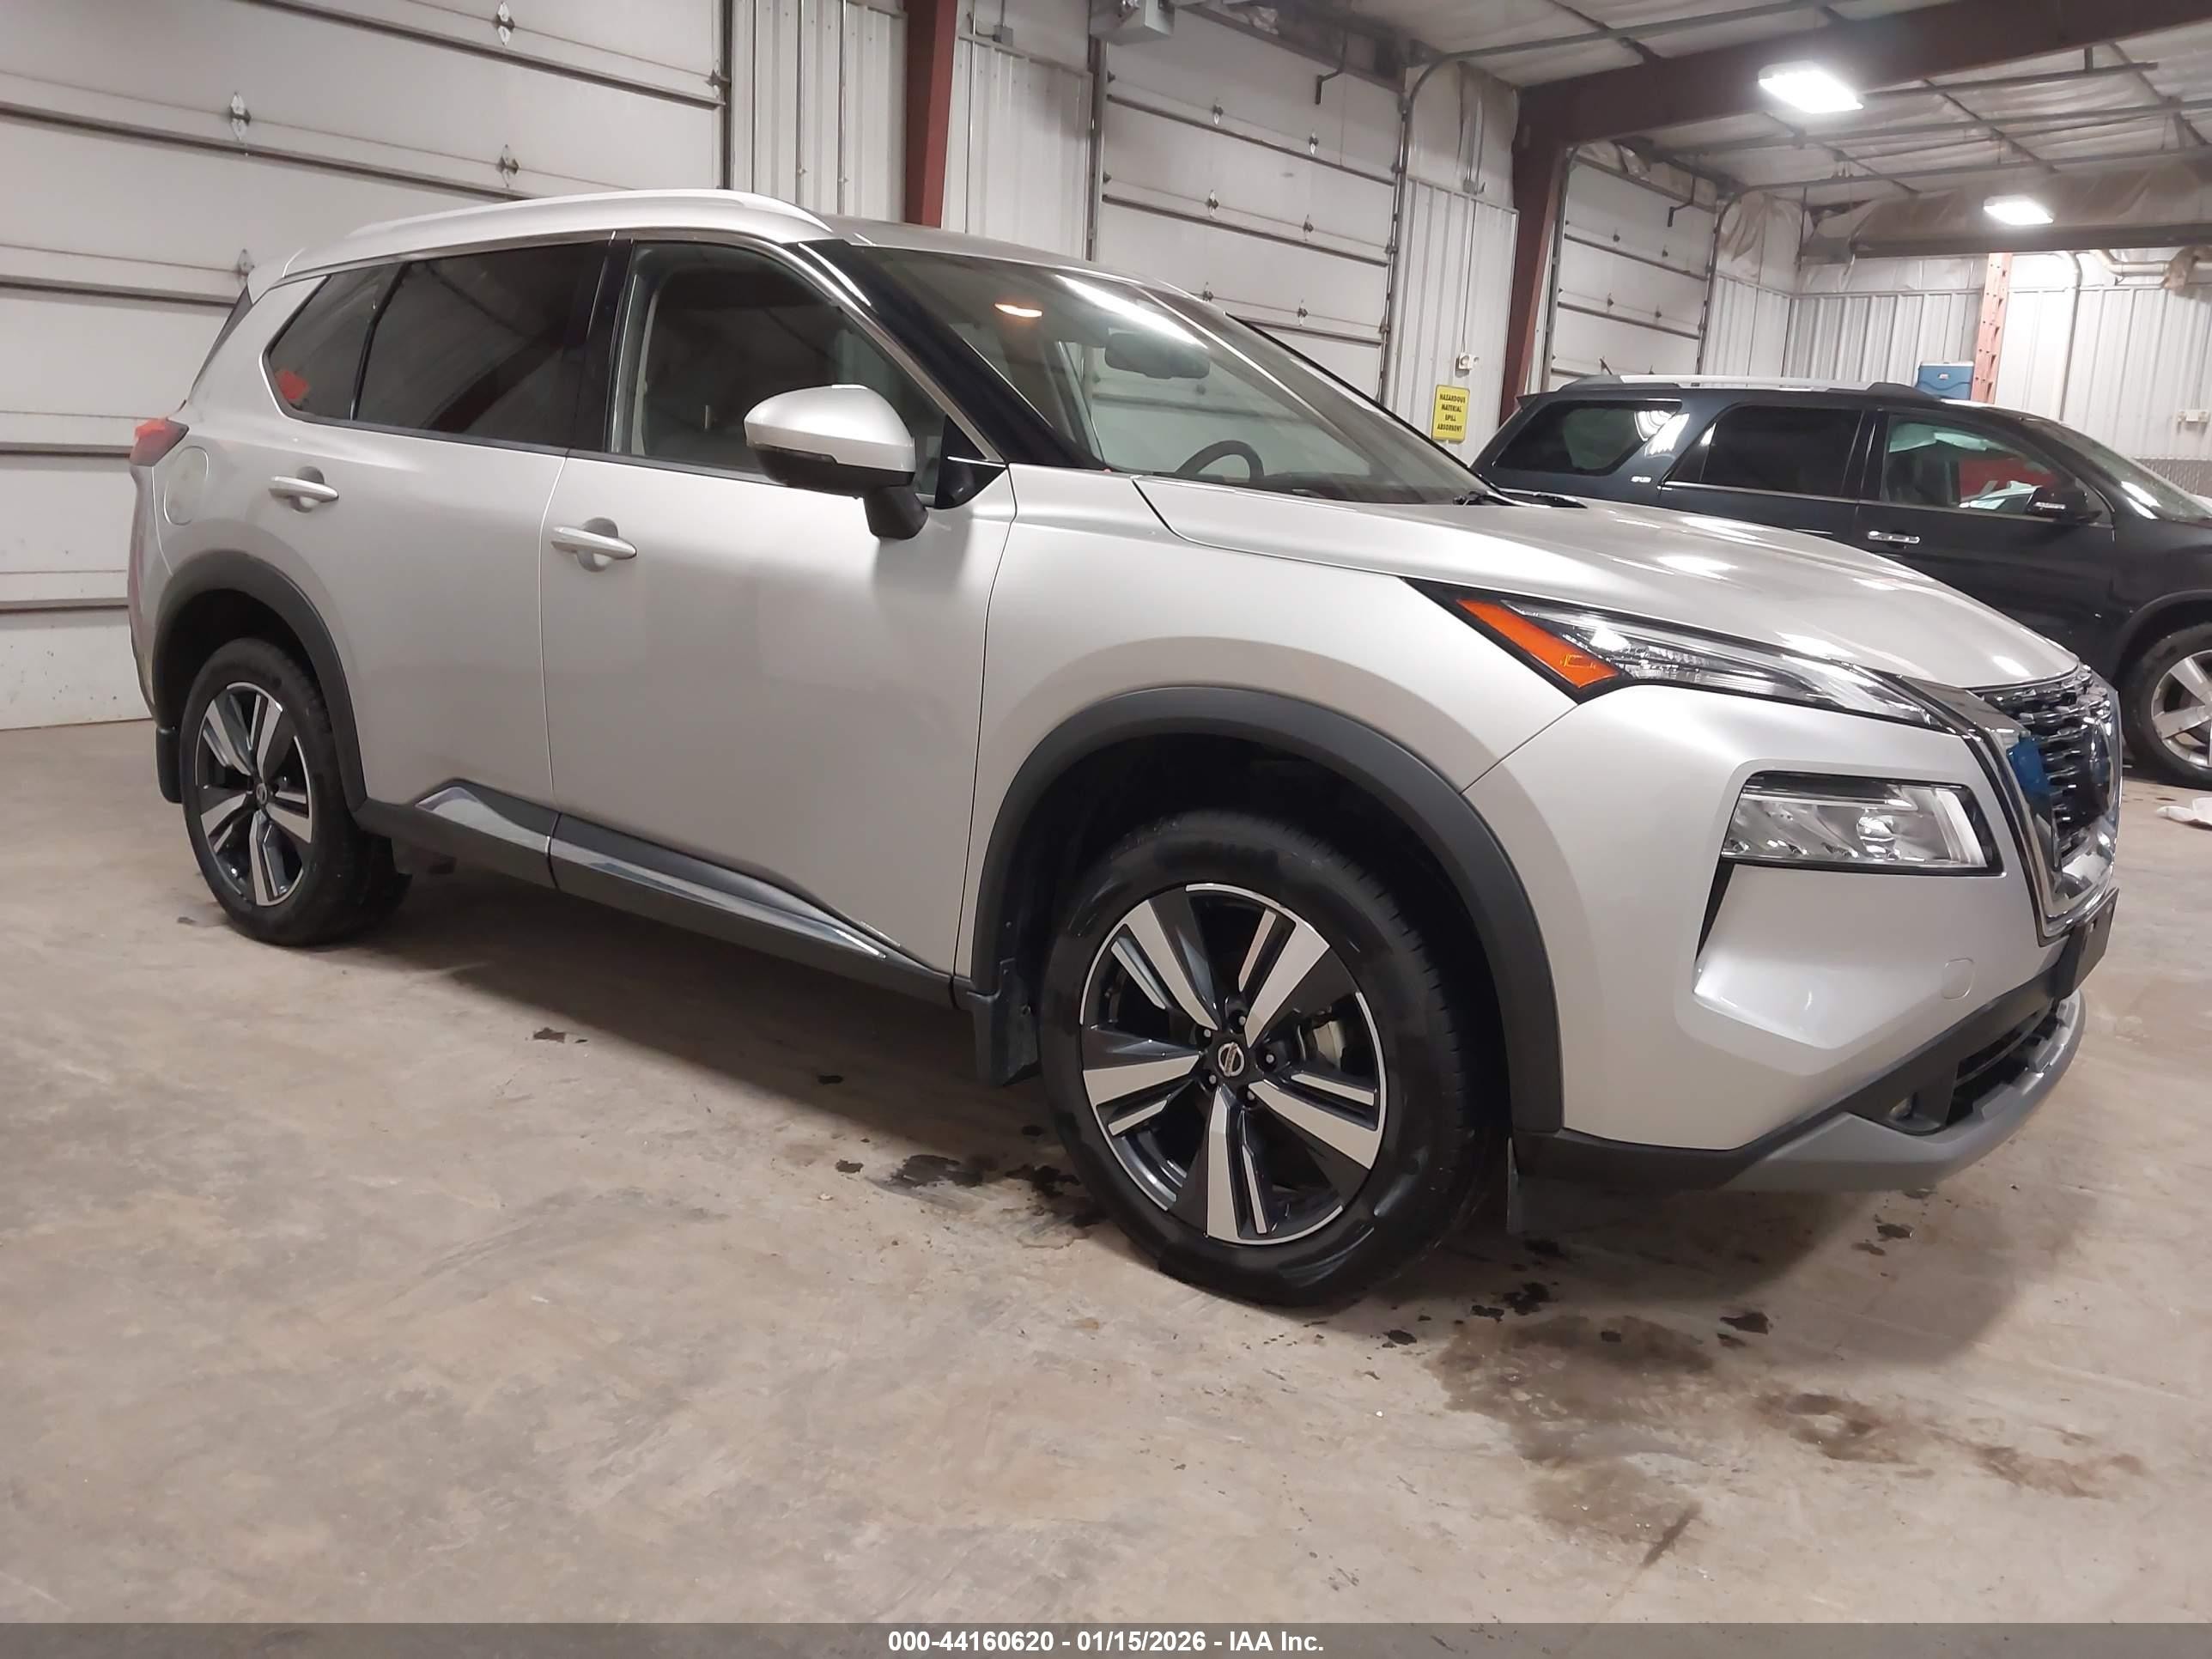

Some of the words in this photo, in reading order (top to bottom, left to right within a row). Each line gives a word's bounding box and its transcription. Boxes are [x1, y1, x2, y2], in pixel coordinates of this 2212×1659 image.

[1439, 393, 1466, 404] HAZARDOUS
[1441, 404, 1462, 413] MATERIAL
[1437, 423, 1462, 433] ABSORBENT
